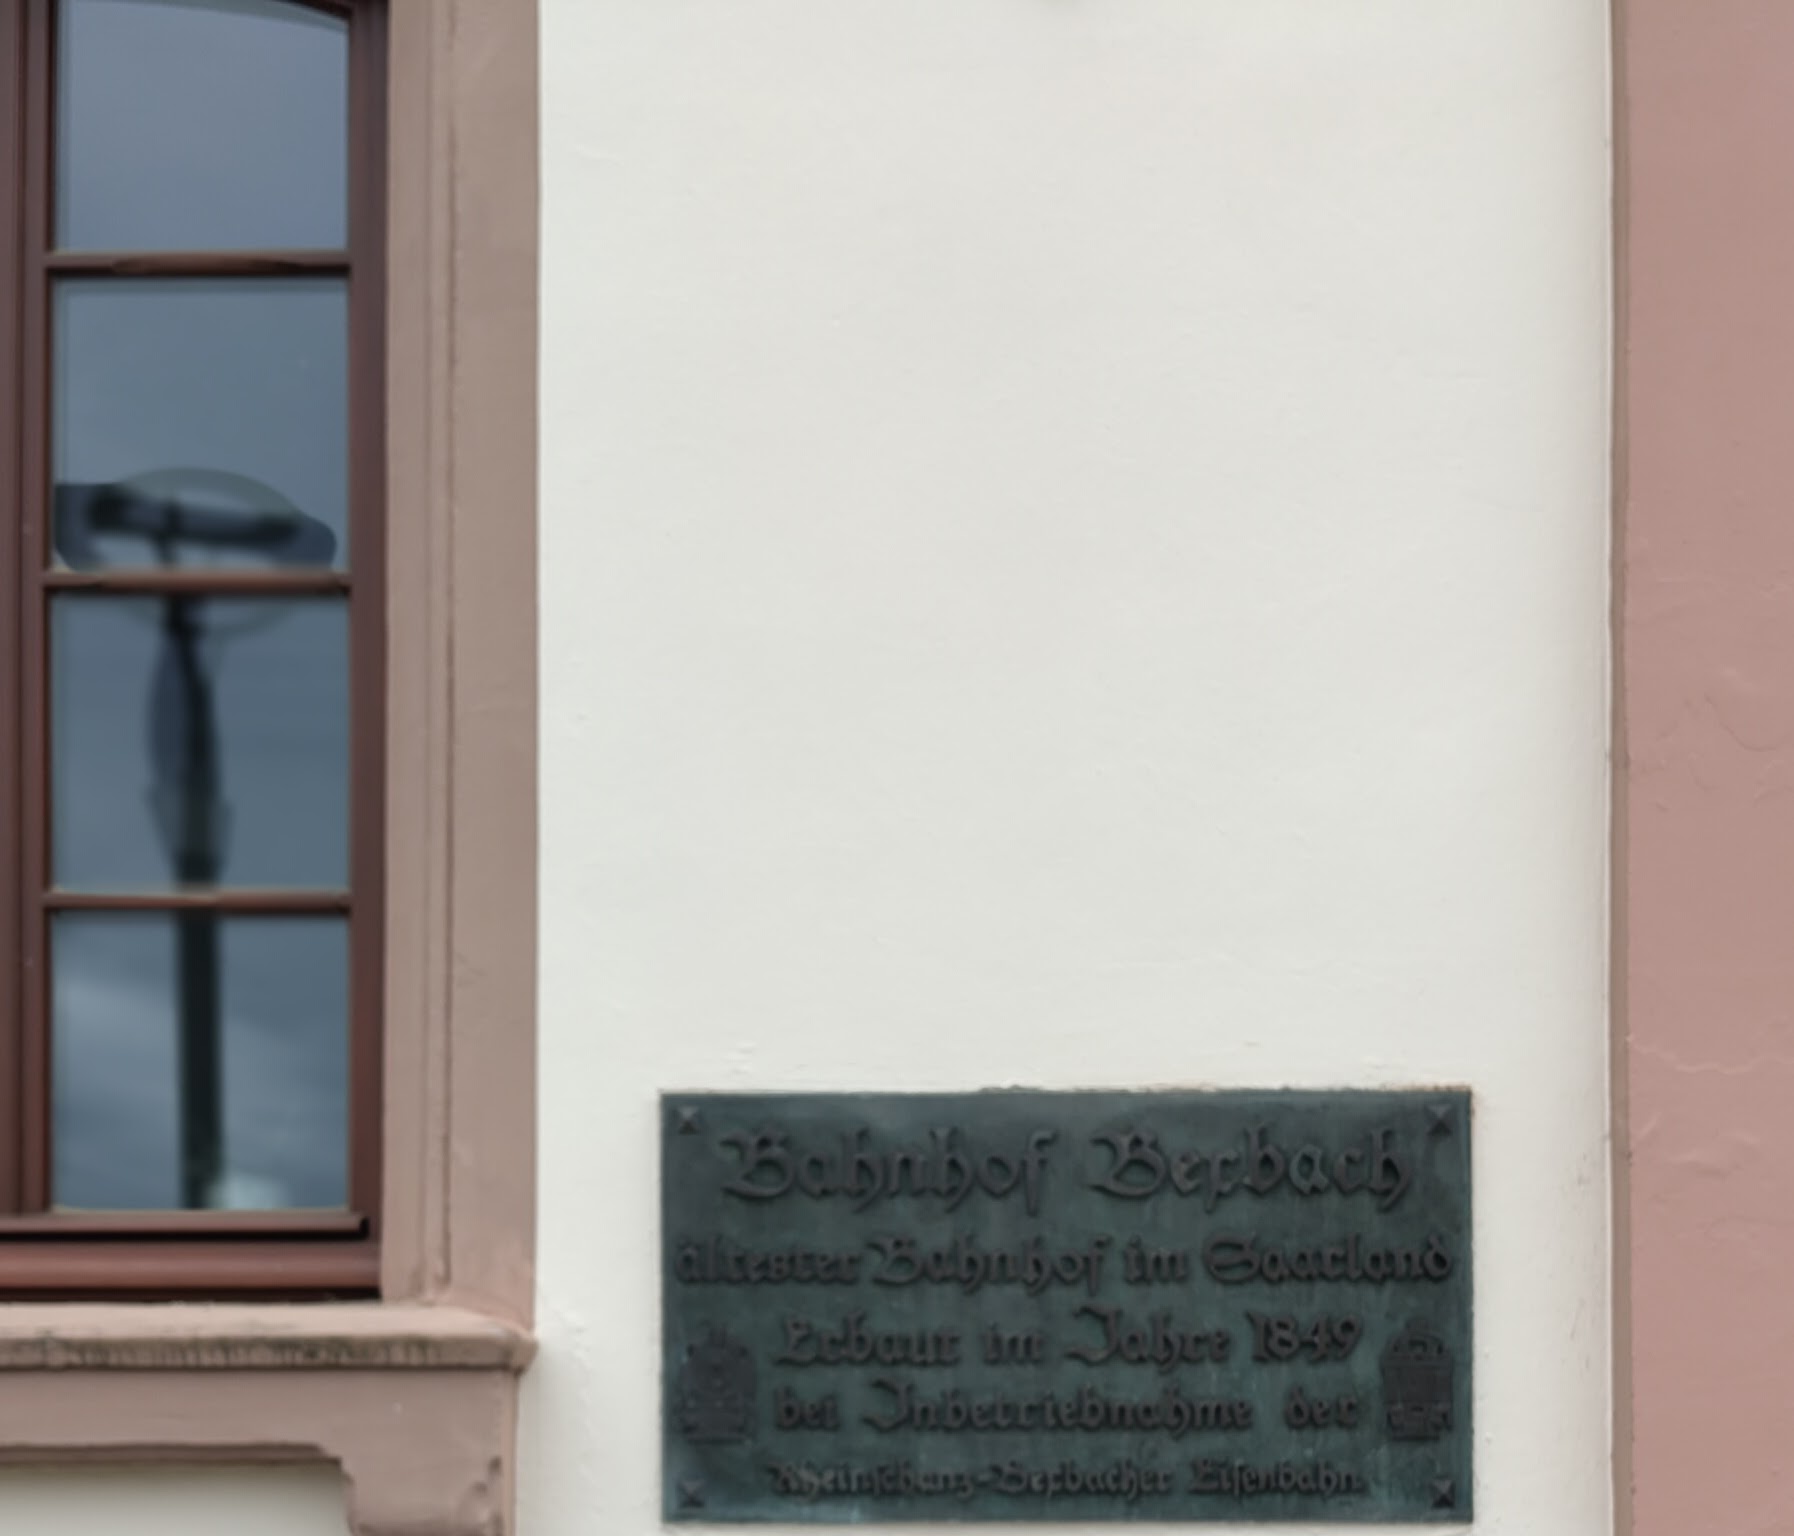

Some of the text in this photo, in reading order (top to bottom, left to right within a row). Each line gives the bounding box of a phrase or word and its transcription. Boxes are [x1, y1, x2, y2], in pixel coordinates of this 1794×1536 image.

[718, 1126, 1060, 1216] Bahnhof
[867, 1233, 1112, 1297] Bahnhof
[1124, 1236, 1189, 1284] im
[1203, 1231, 1452, 1284] Saarland
[773, 1303, 1363, 1372] Erbaut im Jahre 1849
[774, 1385, 840, 1432] bei
[1285, 1386, 1360, 1431] der
